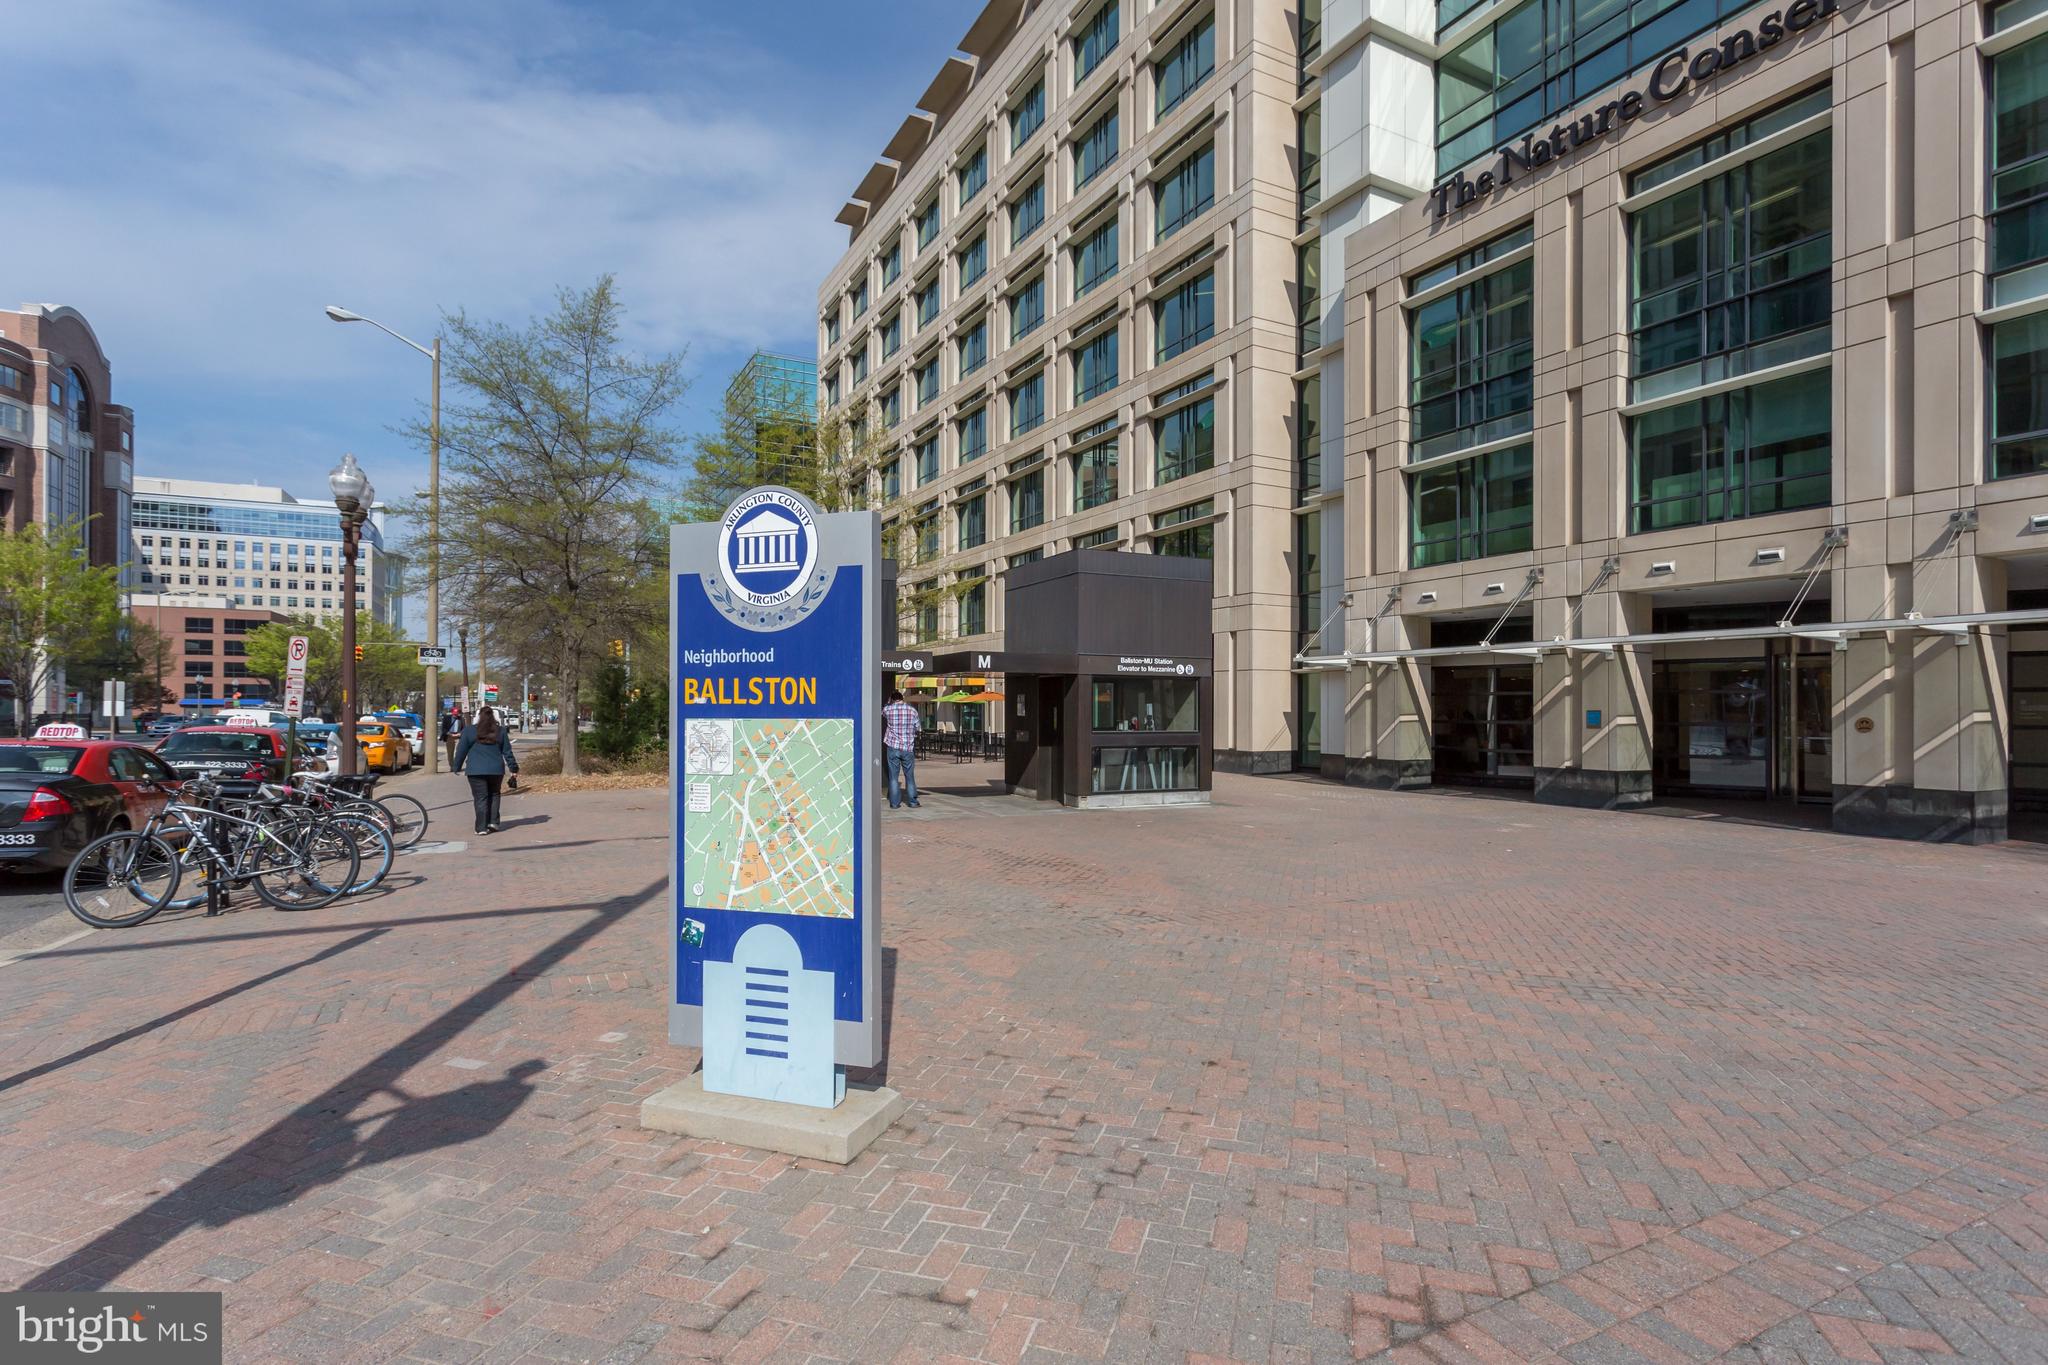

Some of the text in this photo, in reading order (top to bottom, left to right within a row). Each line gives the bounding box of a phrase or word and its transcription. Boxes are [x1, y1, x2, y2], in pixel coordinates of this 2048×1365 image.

[1431, 171, 1494, 217] The
[1498, 90, 1643, 185] Nature
[725, 493, 812, 531] ARLINGTON COUNTY
[747, 590, 791, 605] VIRGINIA
[684, 647, 774, 667] Neighborhood
[978, 655, 991, 669] M
[1120, 657, 1153, 665] Ballston-MU
[684, 677, 817, 705] BALLSTON
[229, 718, 255, 726] REDTOP
[40, 727, 79, 737] REDTOP
[205, 761, 248, 769] 522-3333
